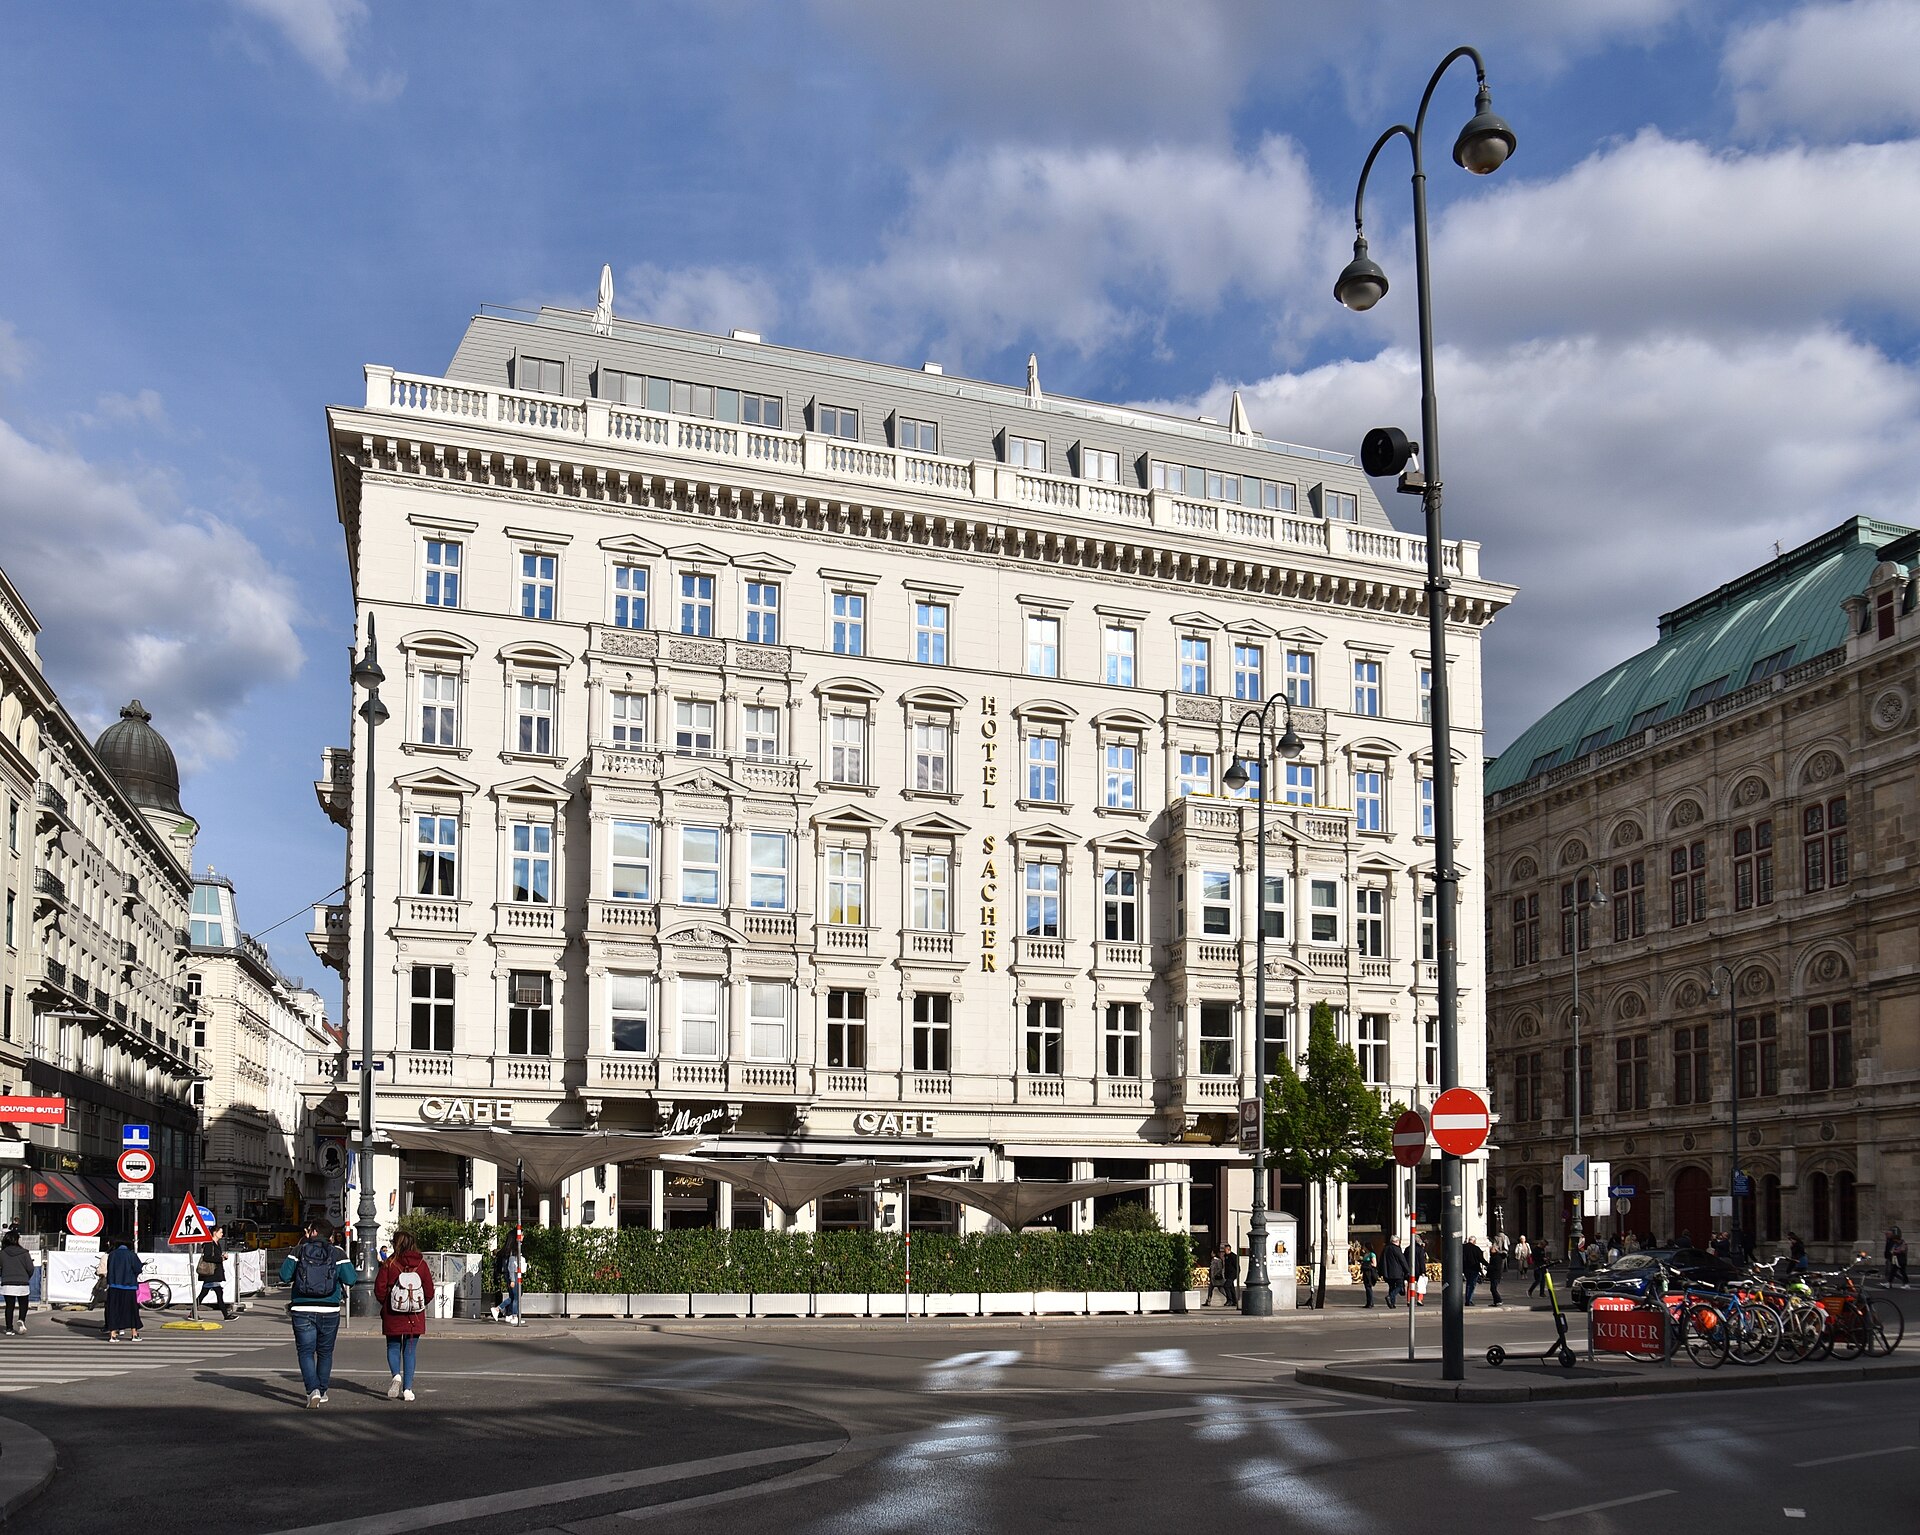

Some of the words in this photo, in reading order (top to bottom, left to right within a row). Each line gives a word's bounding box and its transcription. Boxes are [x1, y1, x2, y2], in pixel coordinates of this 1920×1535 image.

[980, 695, 999, 808] HOTEL
[81, 848, 104, 882] HOTEL
[980, 835, 998, 973] SACHER
[0, 1105, 35, 1113] SOUVENIR
[422, 1097, 515, 1121] CAFE
[859, 1111, 939, 1132] CAFE
[661, 1108, 724, 1137] Mozart
[1597, 1322, 1659, 1340] KURIER
